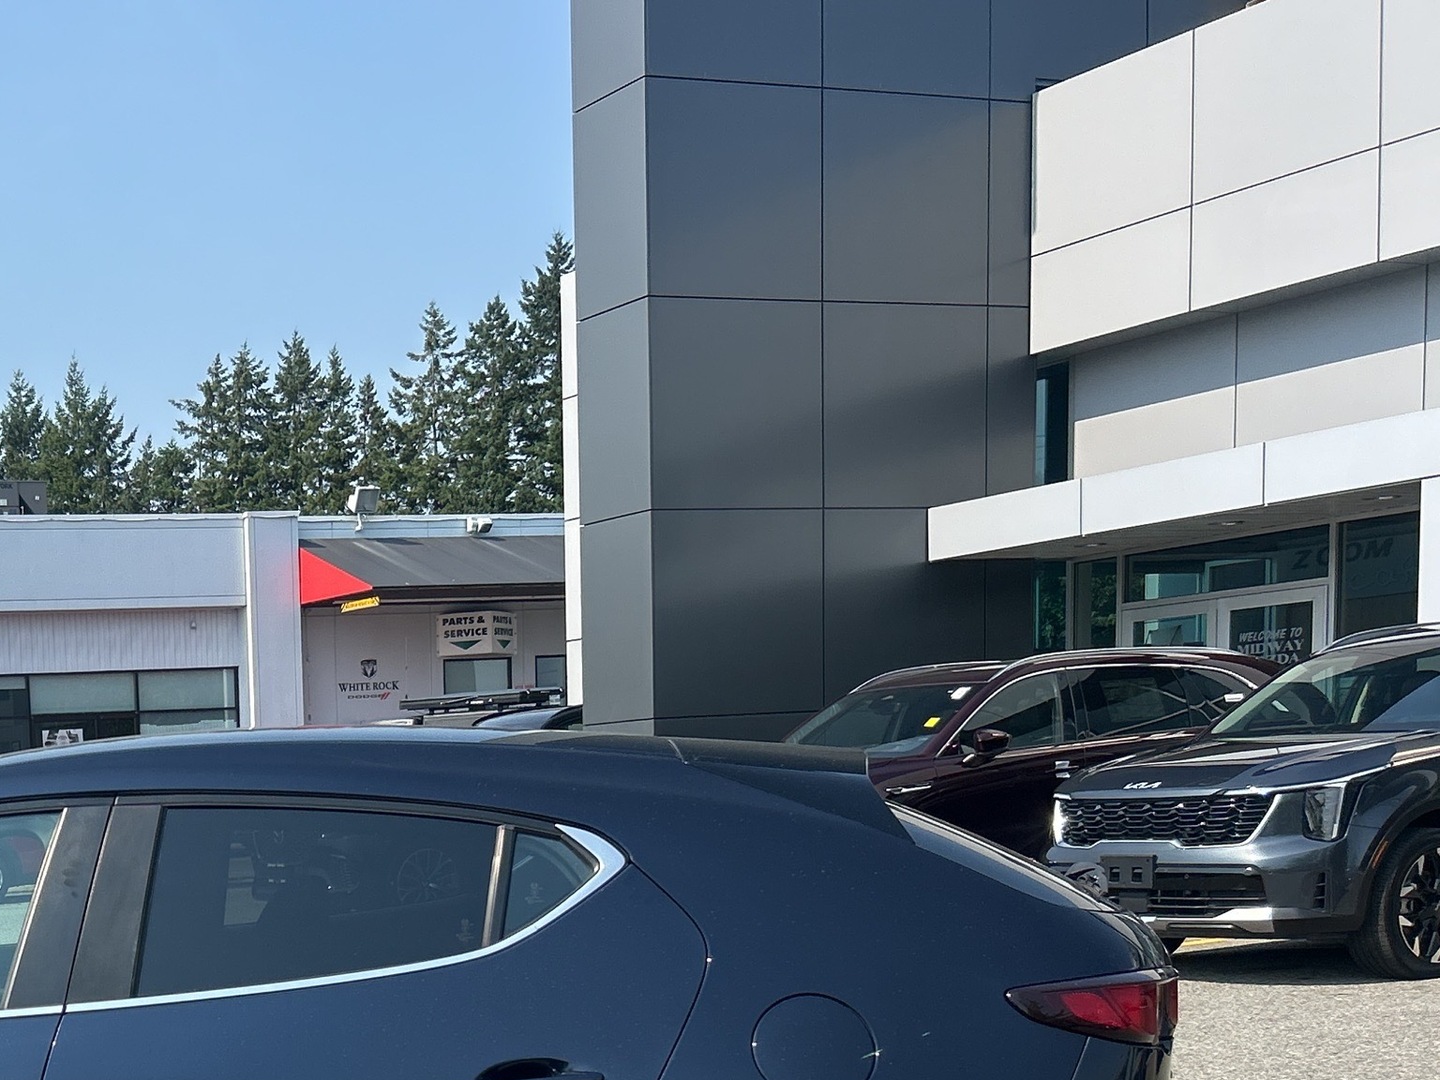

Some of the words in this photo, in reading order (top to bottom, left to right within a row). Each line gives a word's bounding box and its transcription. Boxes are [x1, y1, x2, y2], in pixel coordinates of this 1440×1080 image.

[442, 616, 475, 627] PARTS
[476, 615, 486, 624] &
[492, 615, 508, 625] PARTS
[443, 627, 488, 639] SERVICE
[493, 627, 514, 637] SERVICE
[1238, 628, 1288, 643] WELCOME
[1289, 627, 1303, 638] TO
[1237, 638, 1305, 656] MIDWAY
[338, 682, 371, 692] WHITE
[372, 680, 400, 690] ROCK
